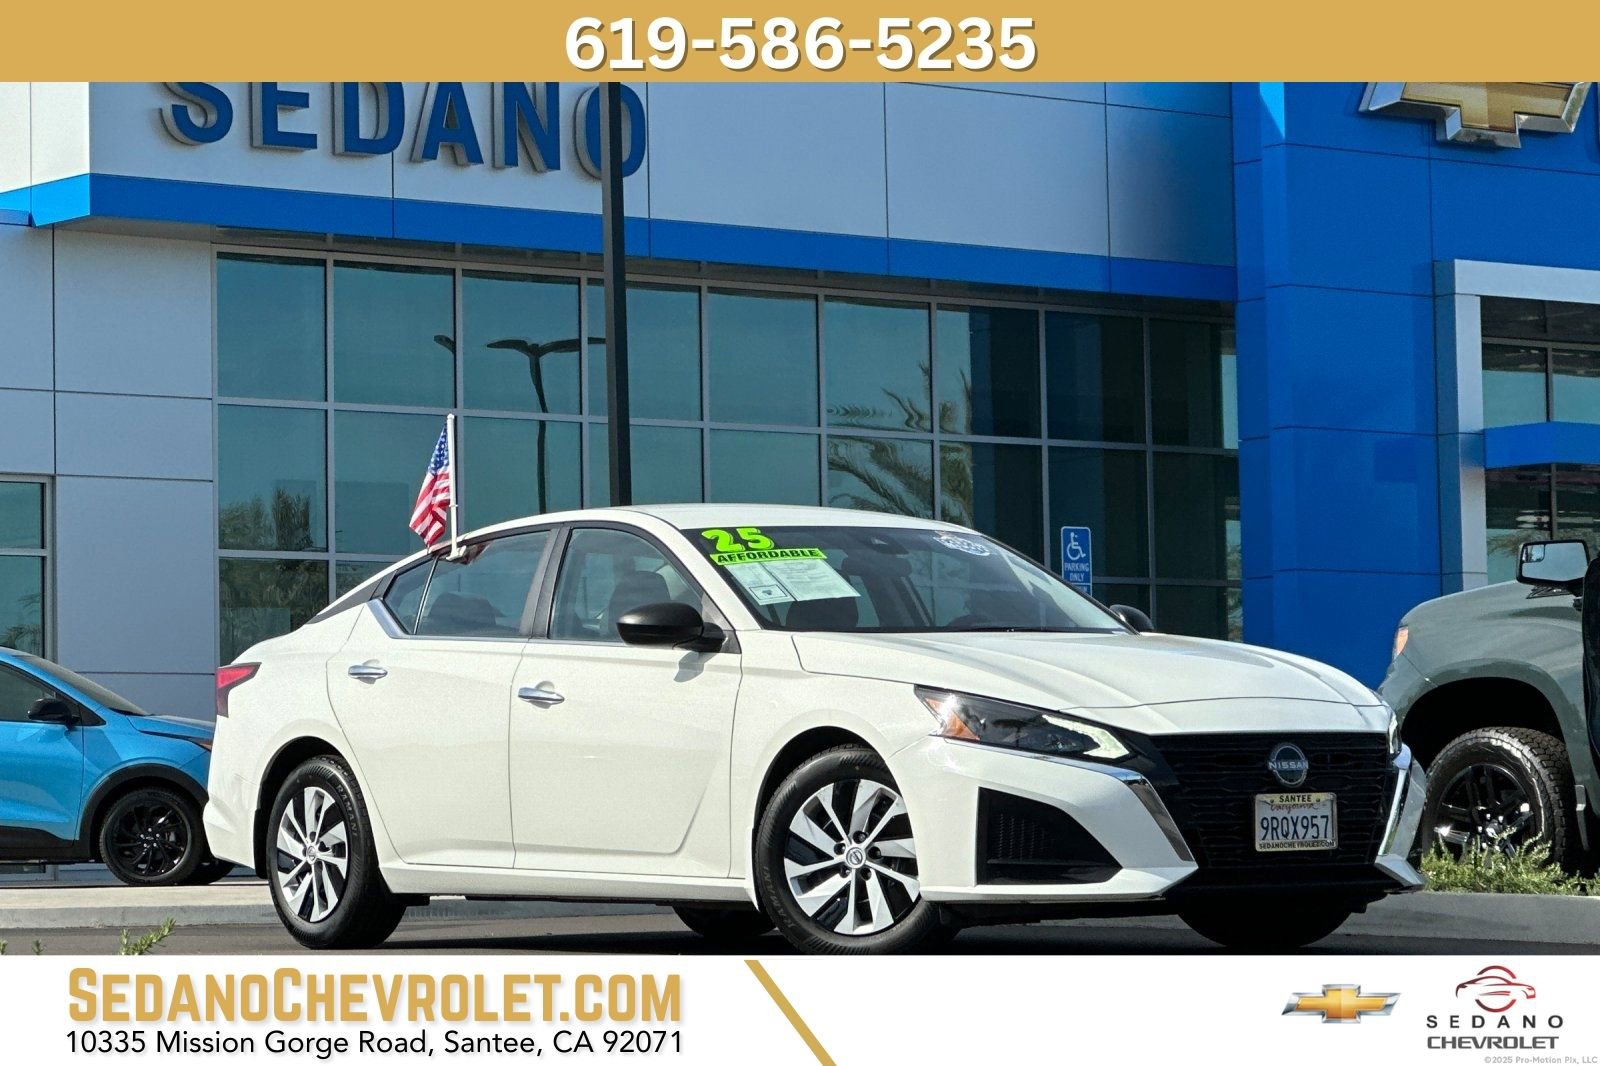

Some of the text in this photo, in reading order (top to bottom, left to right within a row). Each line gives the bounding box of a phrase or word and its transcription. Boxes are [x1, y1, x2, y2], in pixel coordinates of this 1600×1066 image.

[159, 82, 647, 182] SEDANO
[701, 527, 775, 552] 25
[717, 549, 820, 564] AFFORDABLE
[1064, 562, 1090, 572] PARKING
[1069, 572, 1085, 582] ONLY
[1268, 761, 1309, 769] NISSAN
[1279, 794, 1312, 803] SANTEE
[1260, 815, 1329, 841] 9RQX957
